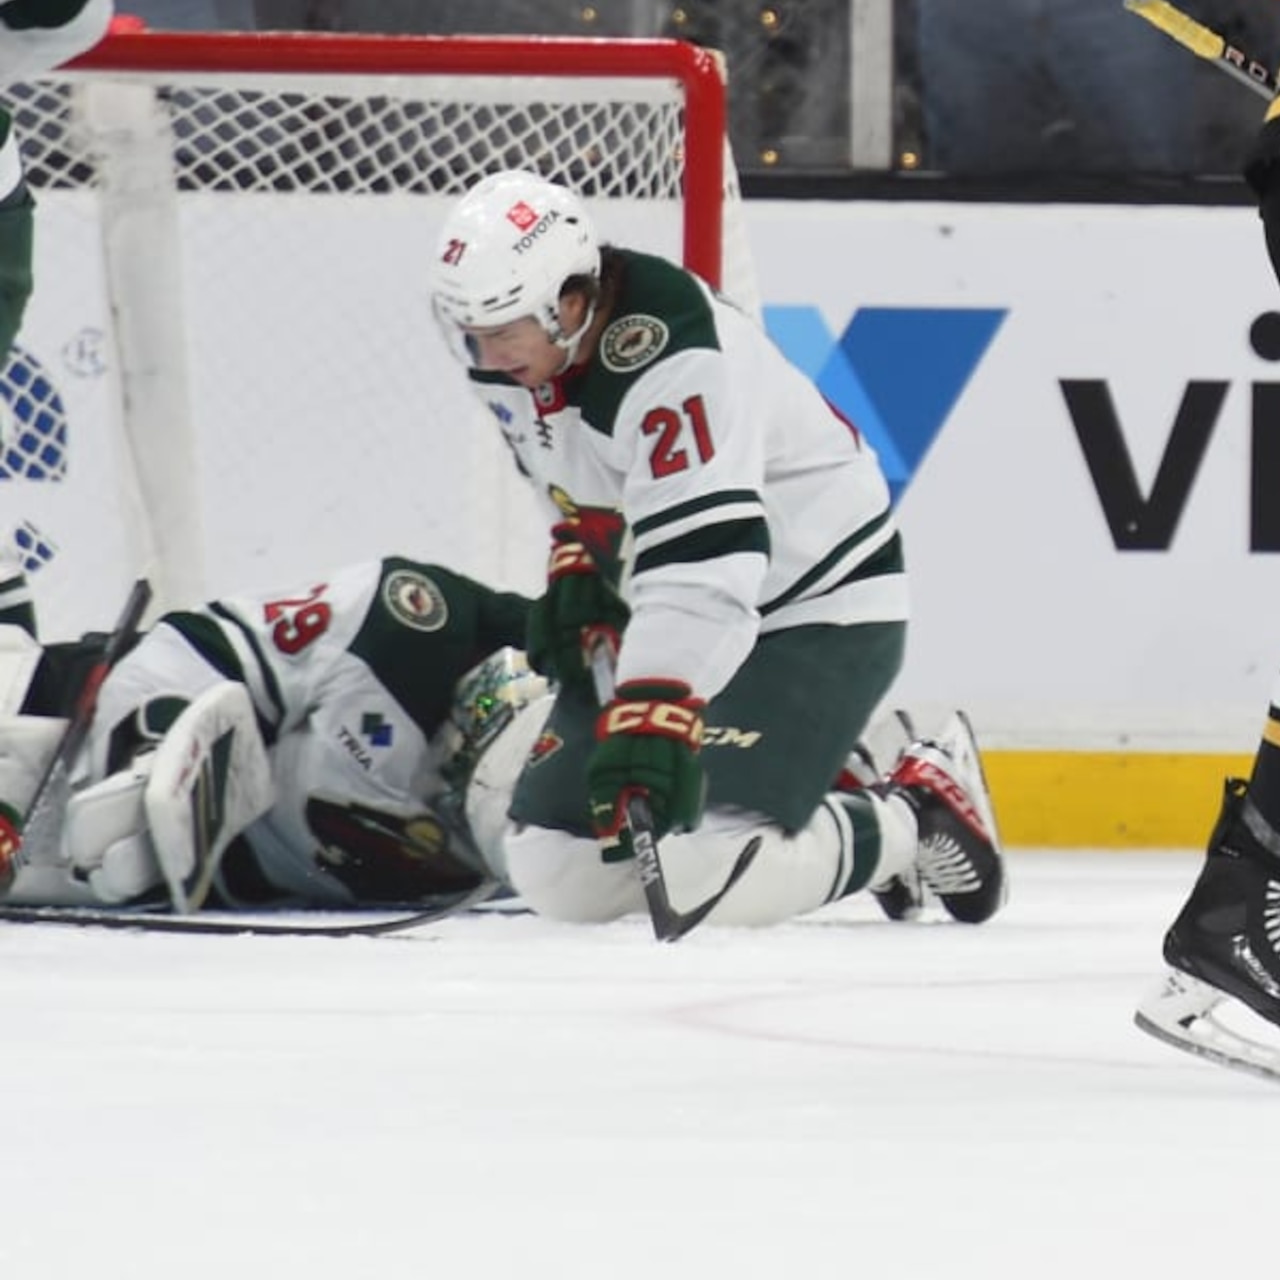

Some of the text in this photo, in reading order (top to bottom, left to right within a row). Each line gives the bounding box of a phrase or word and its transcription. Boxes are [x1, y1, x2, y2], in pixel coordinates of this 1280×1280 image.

[442, 238, 467, 266] 21
[512, 209, 561, 255] TOYOTA
[640, 393, 715, 480] 21
